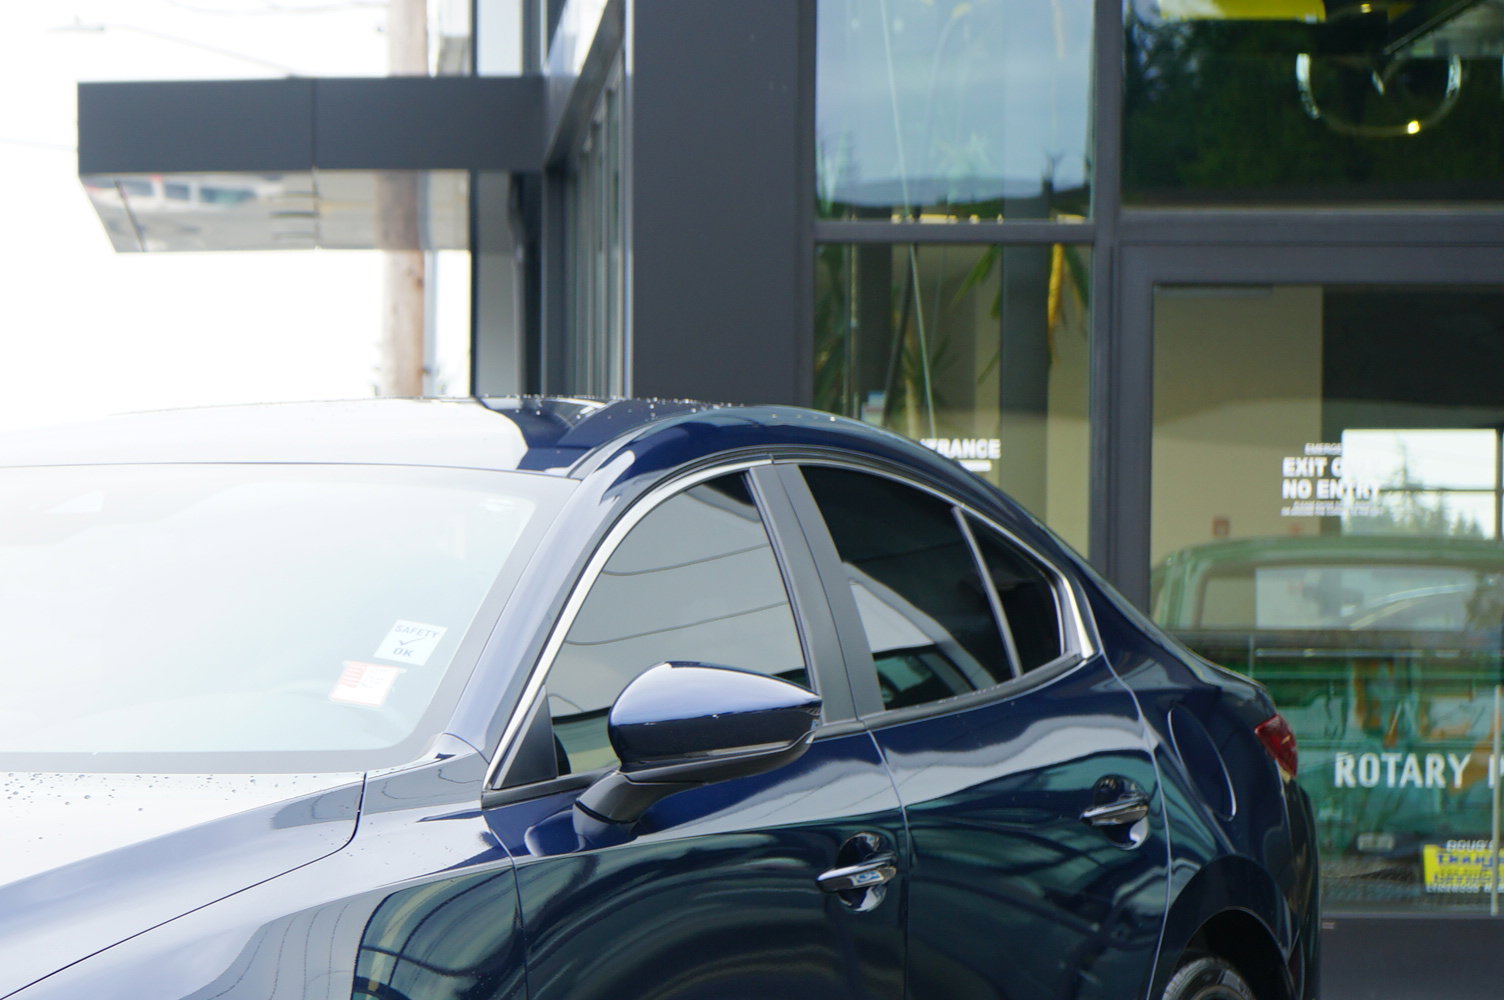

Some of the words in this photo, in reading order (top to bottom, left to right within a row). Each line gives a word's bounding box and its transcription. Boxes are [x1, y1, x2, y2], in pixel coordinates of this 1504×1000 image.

[919, 438, 1001, 459] TRANCE
[1282, 456, 1328, 478] EXIT
[1282, 478, 1312, 500] NO
[394, 624, 439, 639] SAFETY
[392, 647, 415, 658] OK
[1334, 752, 1471, 789] ROTARY
